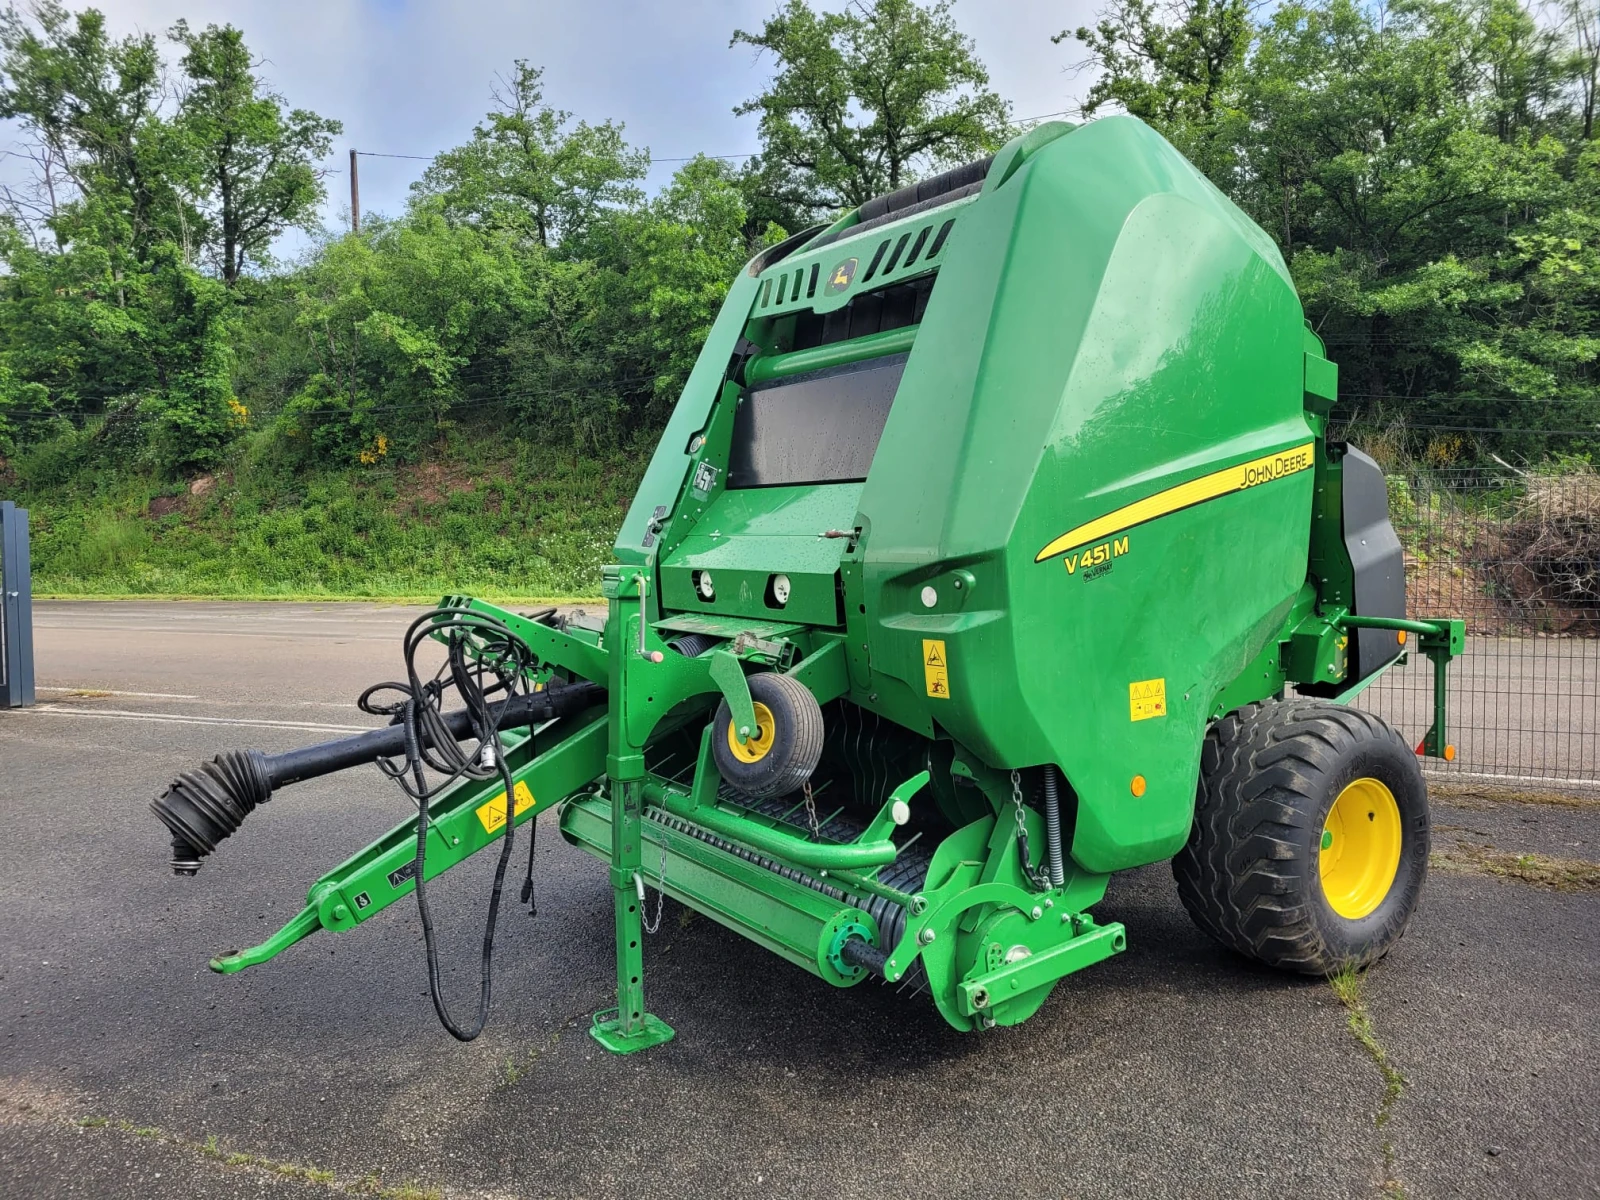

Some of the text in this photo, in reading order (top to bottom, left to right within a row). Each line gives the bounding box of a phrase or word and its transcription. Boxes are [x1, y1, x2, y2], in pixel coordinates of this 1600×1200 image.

[1240, 453, 1307, 486] JOHN DEERE
[1064, 535, 1129, 575] V 451 M
